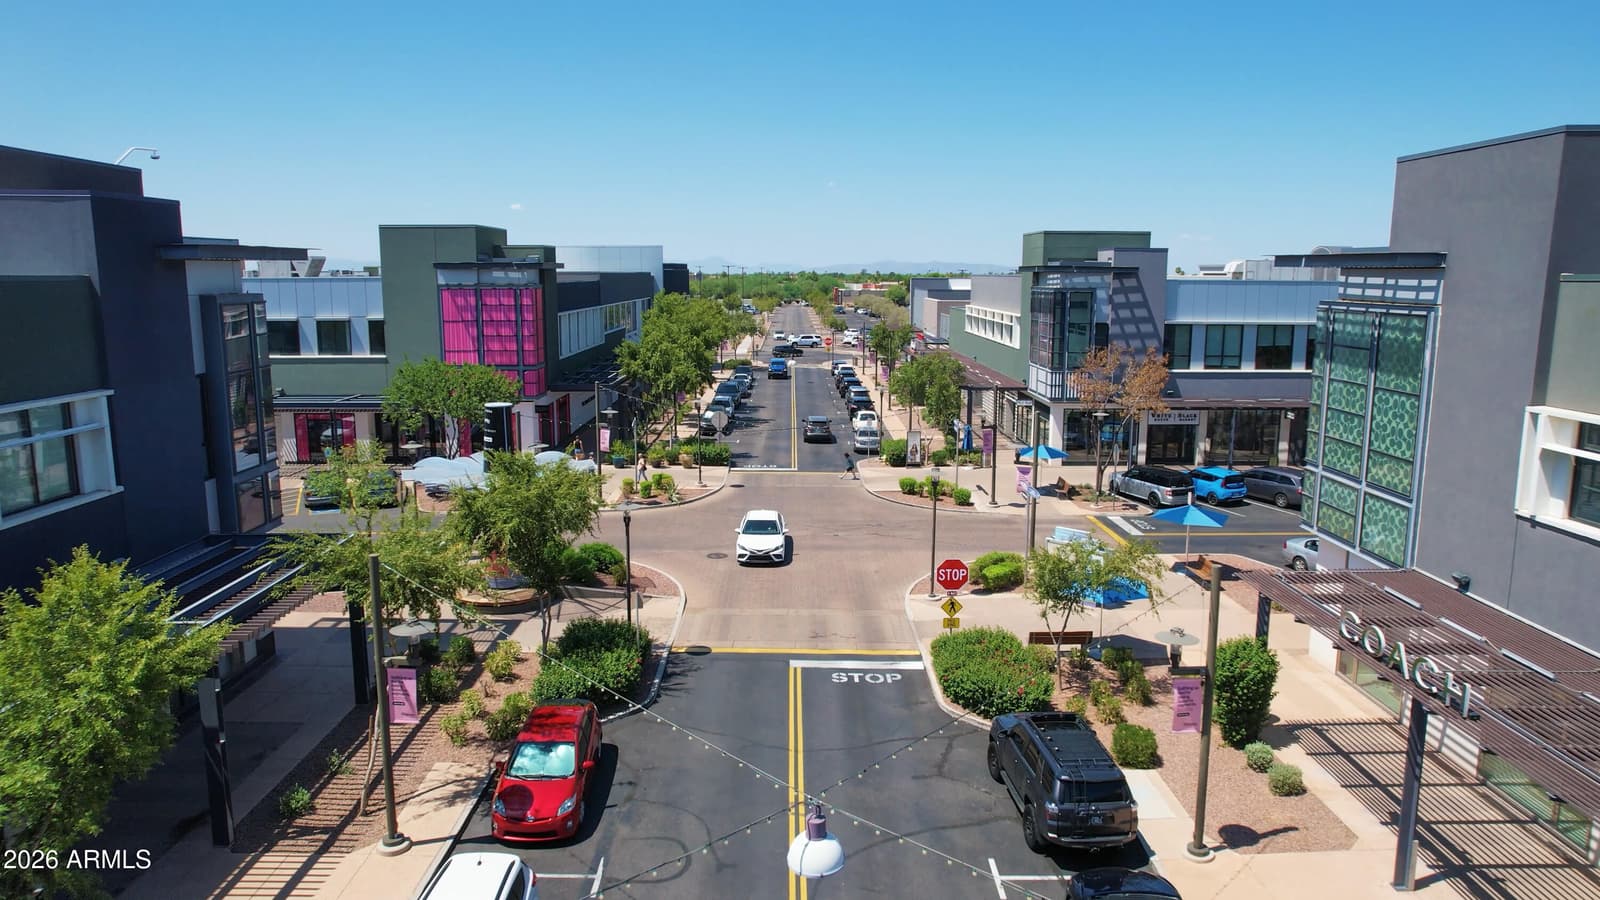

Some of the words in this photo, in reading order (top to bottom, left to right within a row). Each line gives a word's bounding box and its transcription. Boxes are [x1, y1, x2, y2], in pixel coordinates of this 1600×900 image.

[938, 568, 967, 581] STOP
[1339, 610, 1471, 719] COACH
[831, 672, 903, 684] STOP
